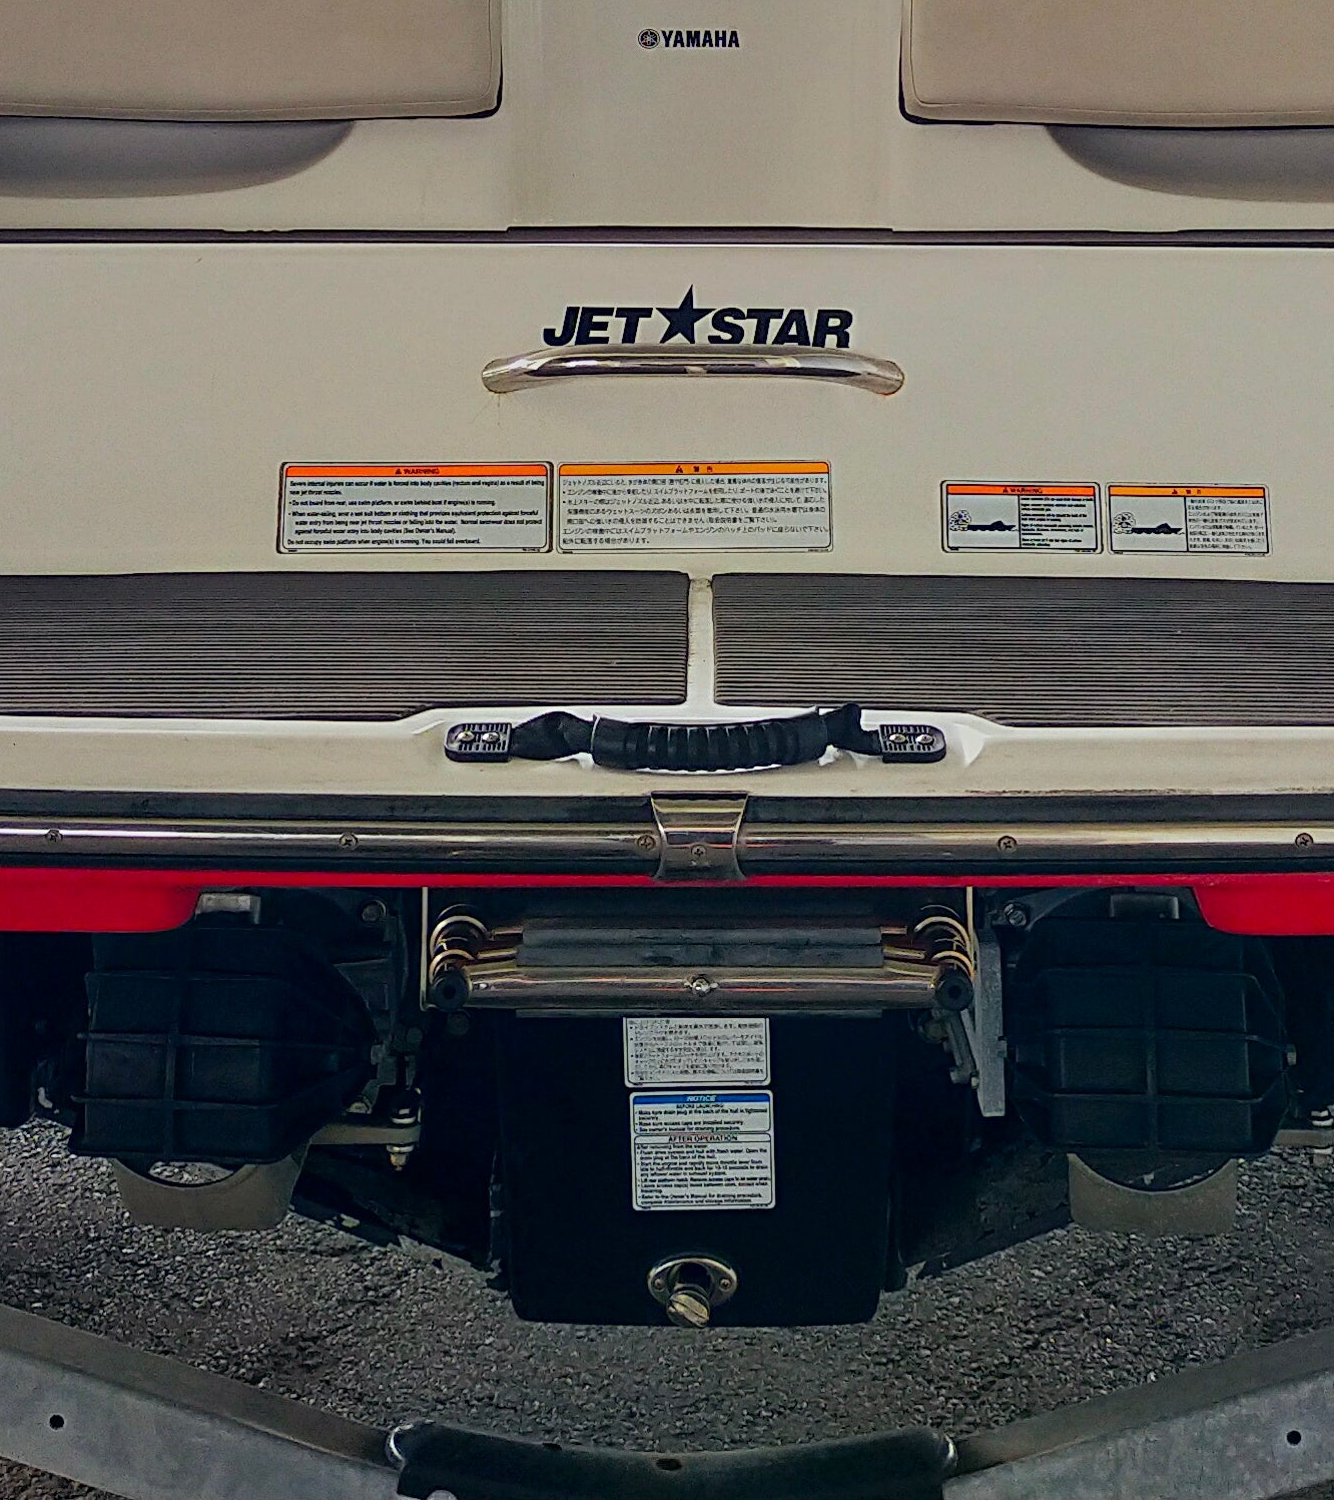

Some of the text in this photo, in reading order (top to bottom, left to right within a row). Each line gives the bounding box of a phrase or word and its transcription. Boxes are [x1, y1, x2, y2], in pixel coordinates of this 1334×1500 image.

[662, 30, 740, 48] YAMAHA
[543, 306, 854, 349] JET STAR
